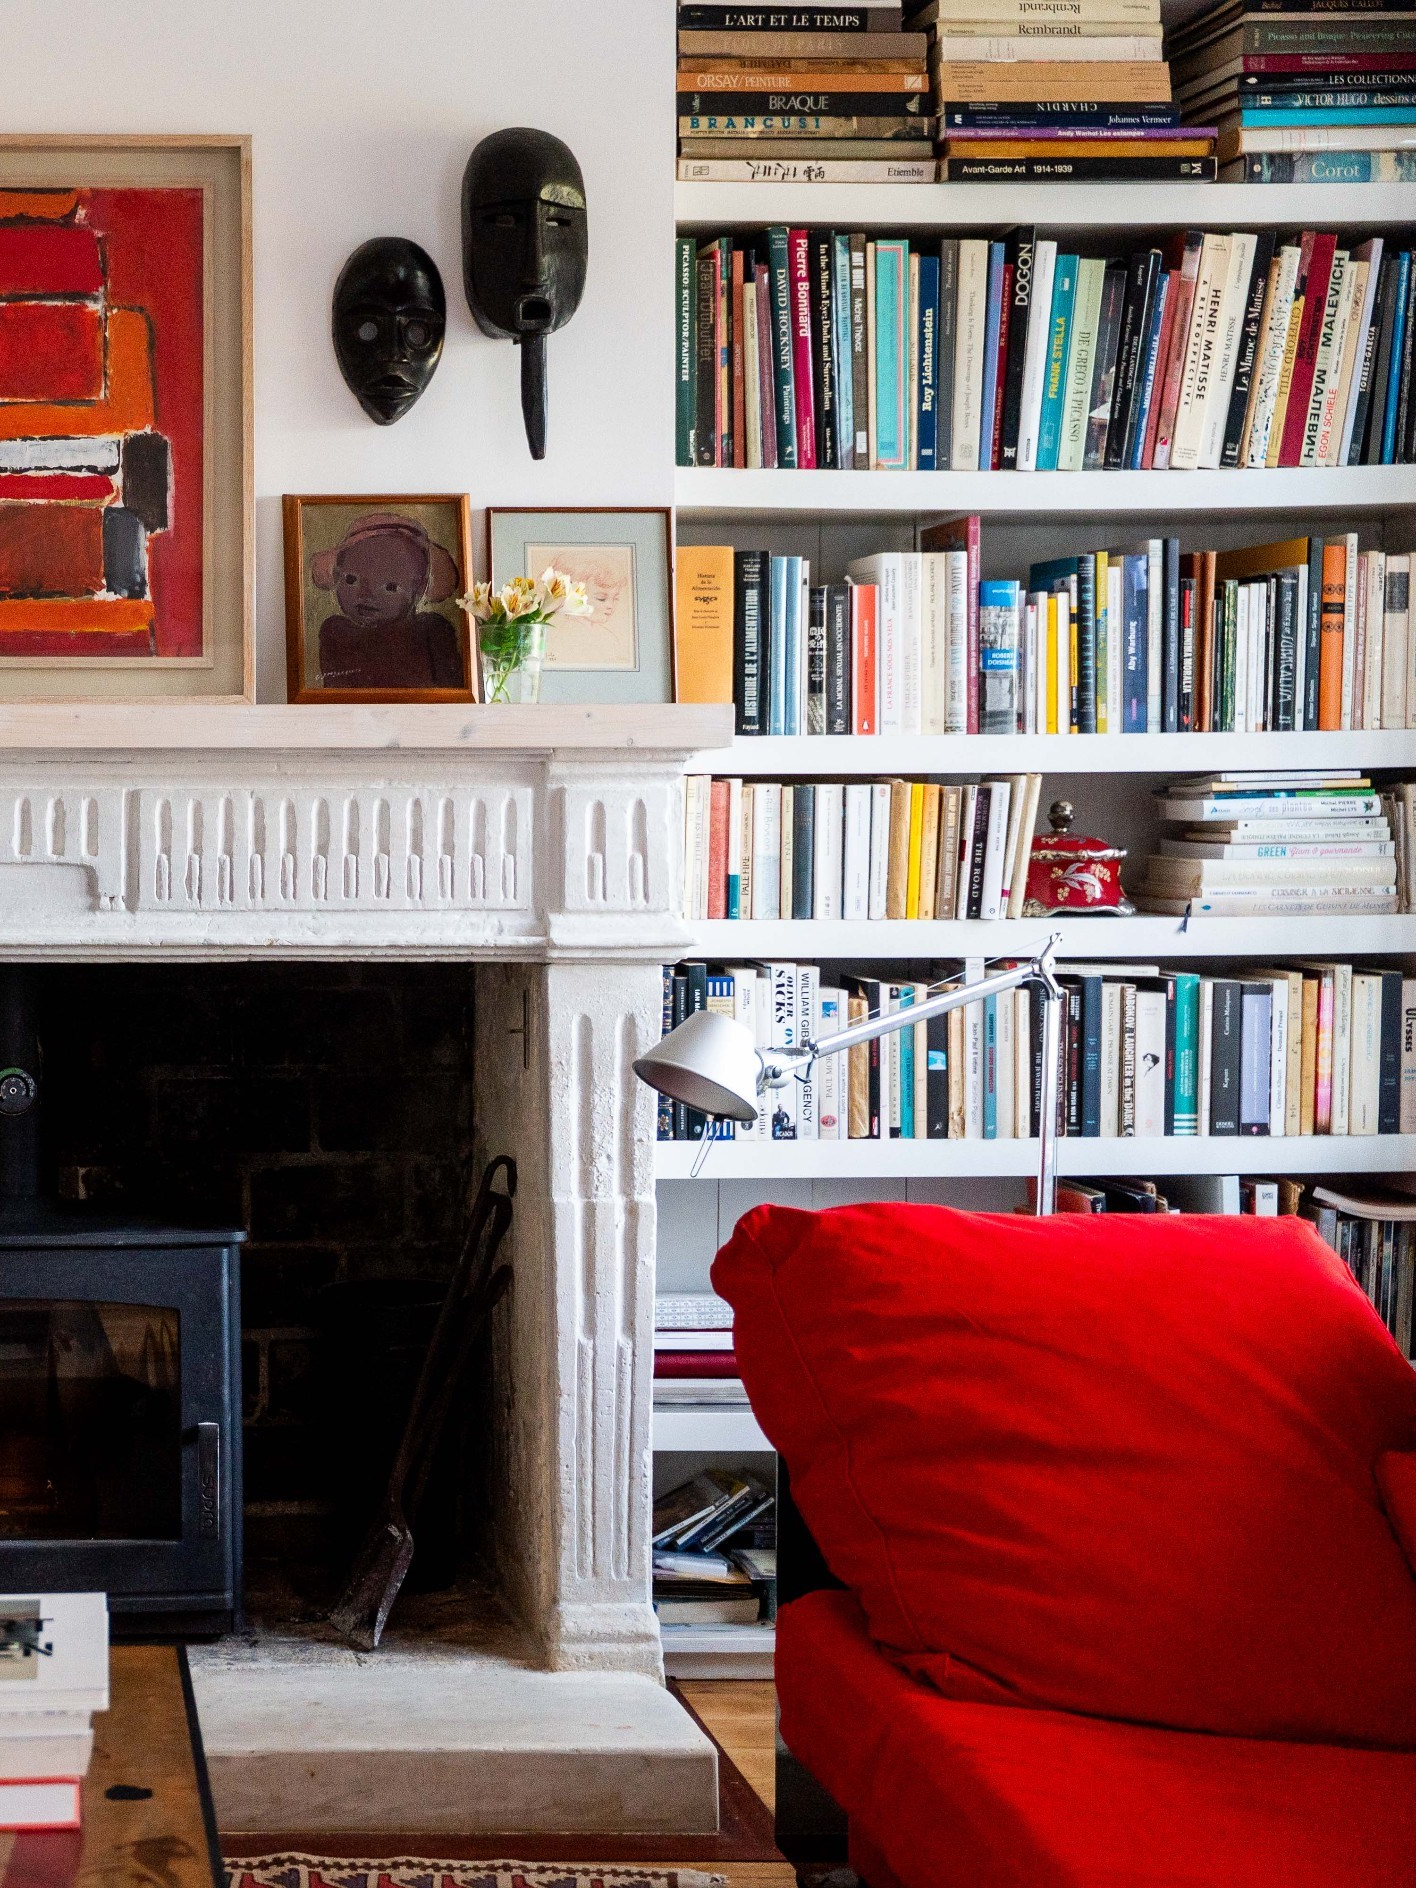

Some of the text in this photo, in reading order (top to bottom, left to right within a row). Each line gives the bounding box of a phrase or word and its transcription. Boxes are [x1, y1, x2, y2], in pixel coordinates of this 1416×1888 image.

[725, 14, 860, 27] L'ART ET LE TEMPS
[1019, 2, 1081, 14] Rembrandt
[1018, 24, 1081, 36] Rembrandt
[1297, 93, 1410, 106] VICTOR HUGO dessins
[1329, 75, 1344, 85] LES
[690, 117, 821, 130] BRANCUSI
[769, 96, 829, 112] BRAQUE
[1036, 103, 1098, 111] CHARDIN
[1108, 115, 1172, 125] Johannes Vermeer
[887, 167, 924, 177] Etiemble
[962, 165, 1073, 174] Avant-Garde Art 1914-1939
[1311, 160, 1360, 178] Corot
[819, 244, 828, 253] In
[820, 255, 828, 269] the
[795, 239, 811, 337] Pierre Bonnard
[820, 270, 829, 299] Mind's
[1015, 243, 1032, 306] DOGON
[681, 244, 690, 382] PICASSO: SCULPTOR/PAINTER
[852, 252, 864, 352] ART BRUT Michel Thévoz
[1321, 256, 1345, 348] MALEVICH
[776, 269, 791, 425] DAVID HOCKNEY Paintings
[821, 321, 830, 343] Dada
[1078, 331, 1090, 346] DE
[1183, 296, 1206, 407] RETROSPECTIVE
[1195, 289, 1221, 401] HENRI MATISSE
[1219, 315, 1236, 382] HENRI MATISSE
[1237, 278, 1266, 391] Le Maroc de Matisse
[1278, 306, 1302, 397] CLYFFORD STILL
[822, 344, 830, 361] and
[922, 308, 934, 411] Roy Lichtenstein
[1048, 317, 1066, 398] FRANK STELLA
[1074, 349, 1089, 385] GRECO
[1359, 326, 1376, 392] TORRES-GARCIA
[823, 362, 831, 410] Surrealism
[1069, 400, 1082, 442] PICASSO
[1303, 369, 1326, 458] МАЛЕВИЧ
[1319, 388, 1337, 459] EGON SCHIELE
[744, 589, 757, 716] HISTOIRE DE L'ALIMENTATION
[836, 642, 843, 650] EN
[1128, 621, 1138, 671] Aby Warburg
[1182, 627, 1193, 693] MINIMA MORALIA
[836, 701, 843, 710] LA
[887, 701, 893, 710] LA
[971, 842, 983, 898] THE ROAD
[1257, 846, 1286, 857] GREEN
[1319, 847, 1362, 856] gourmande
[741, 856, 750, 896] PALE FIRE
[774, 969, 794, 1045] OLIVER SACKS ON
[1404, 1007, 1416, 1053] ULYSSES
[1124, 1033, 1134, 1077] LAUGHTER
[802, 1080, 812, 1123] AGENCY
[1124, 1087, 1133, 1101] the
[1125, 1078, 1134, 1087] in
[1124, 1103, 1133, 1126] DARK
